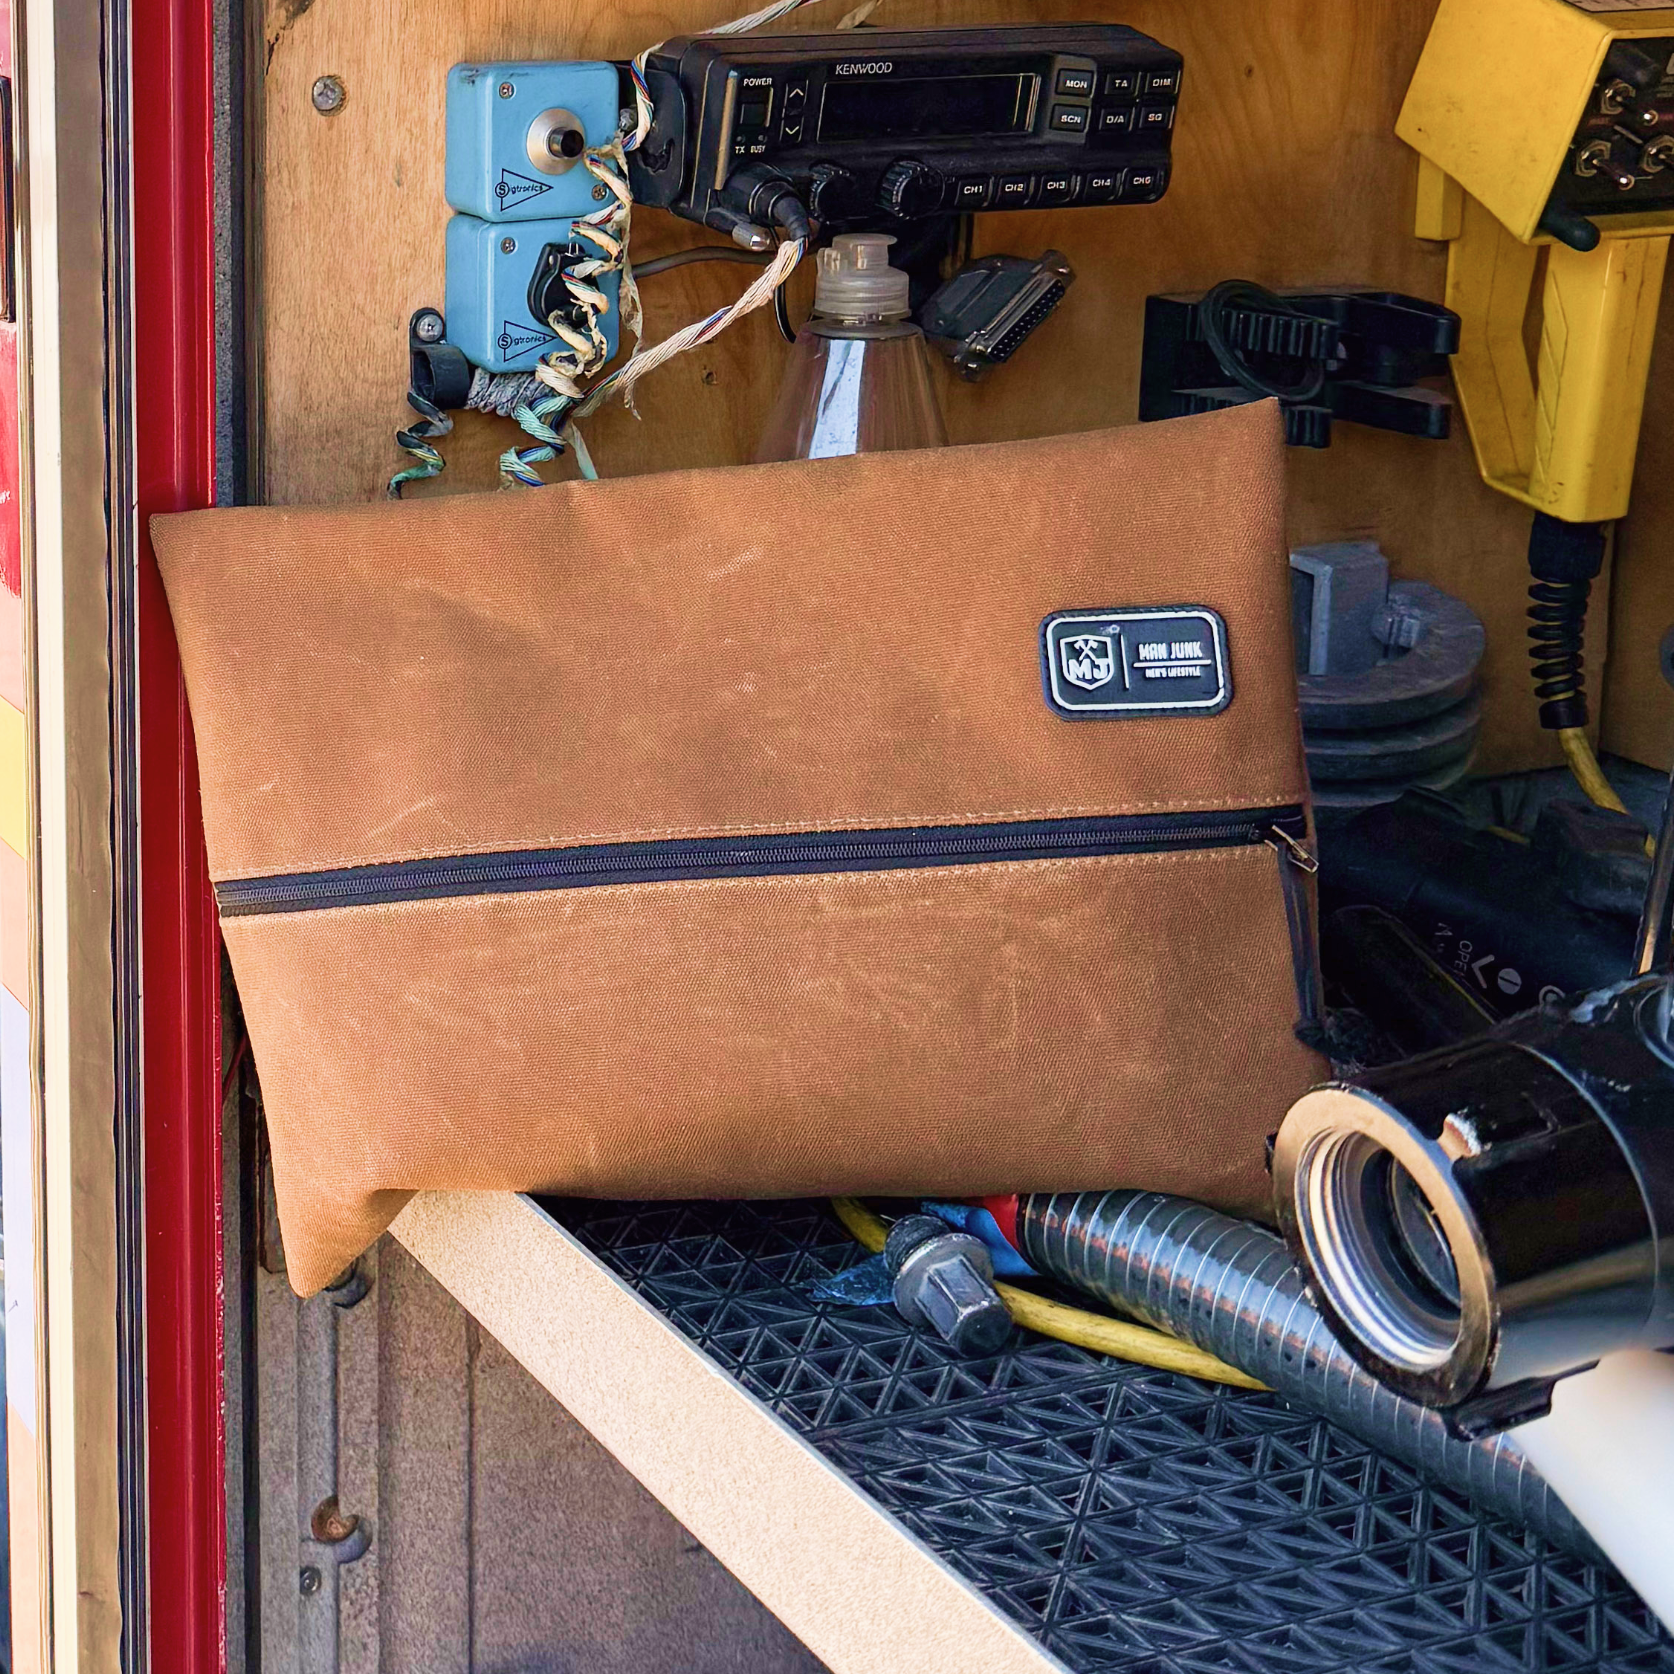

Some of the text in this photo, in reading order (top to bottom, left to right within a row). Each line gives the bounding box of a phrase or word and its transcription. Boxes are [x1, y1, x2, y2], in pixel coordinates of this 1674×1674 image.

[835, 62, 893, 75] KENWOOD
[743, 78, 773, 87] POWER
[1065, 79, 1088, 89] MON
[1060, 114, 1082, 124] SCN
[1106, 115, 1125, 124] D/A
[735, 145, 746, 154] TX
[750, 145, 766, 154] BUSY
[1005, 183, 1024, 192] CH2
[1047, 181, 1066, 190] CH3
[1092, 179, 1111, 187] CH4
[963, 185, 983, 194] CH1
[1139, 641, 1203, 660] MAN JUNK
[1068, 658, 1110, 681] MJ
